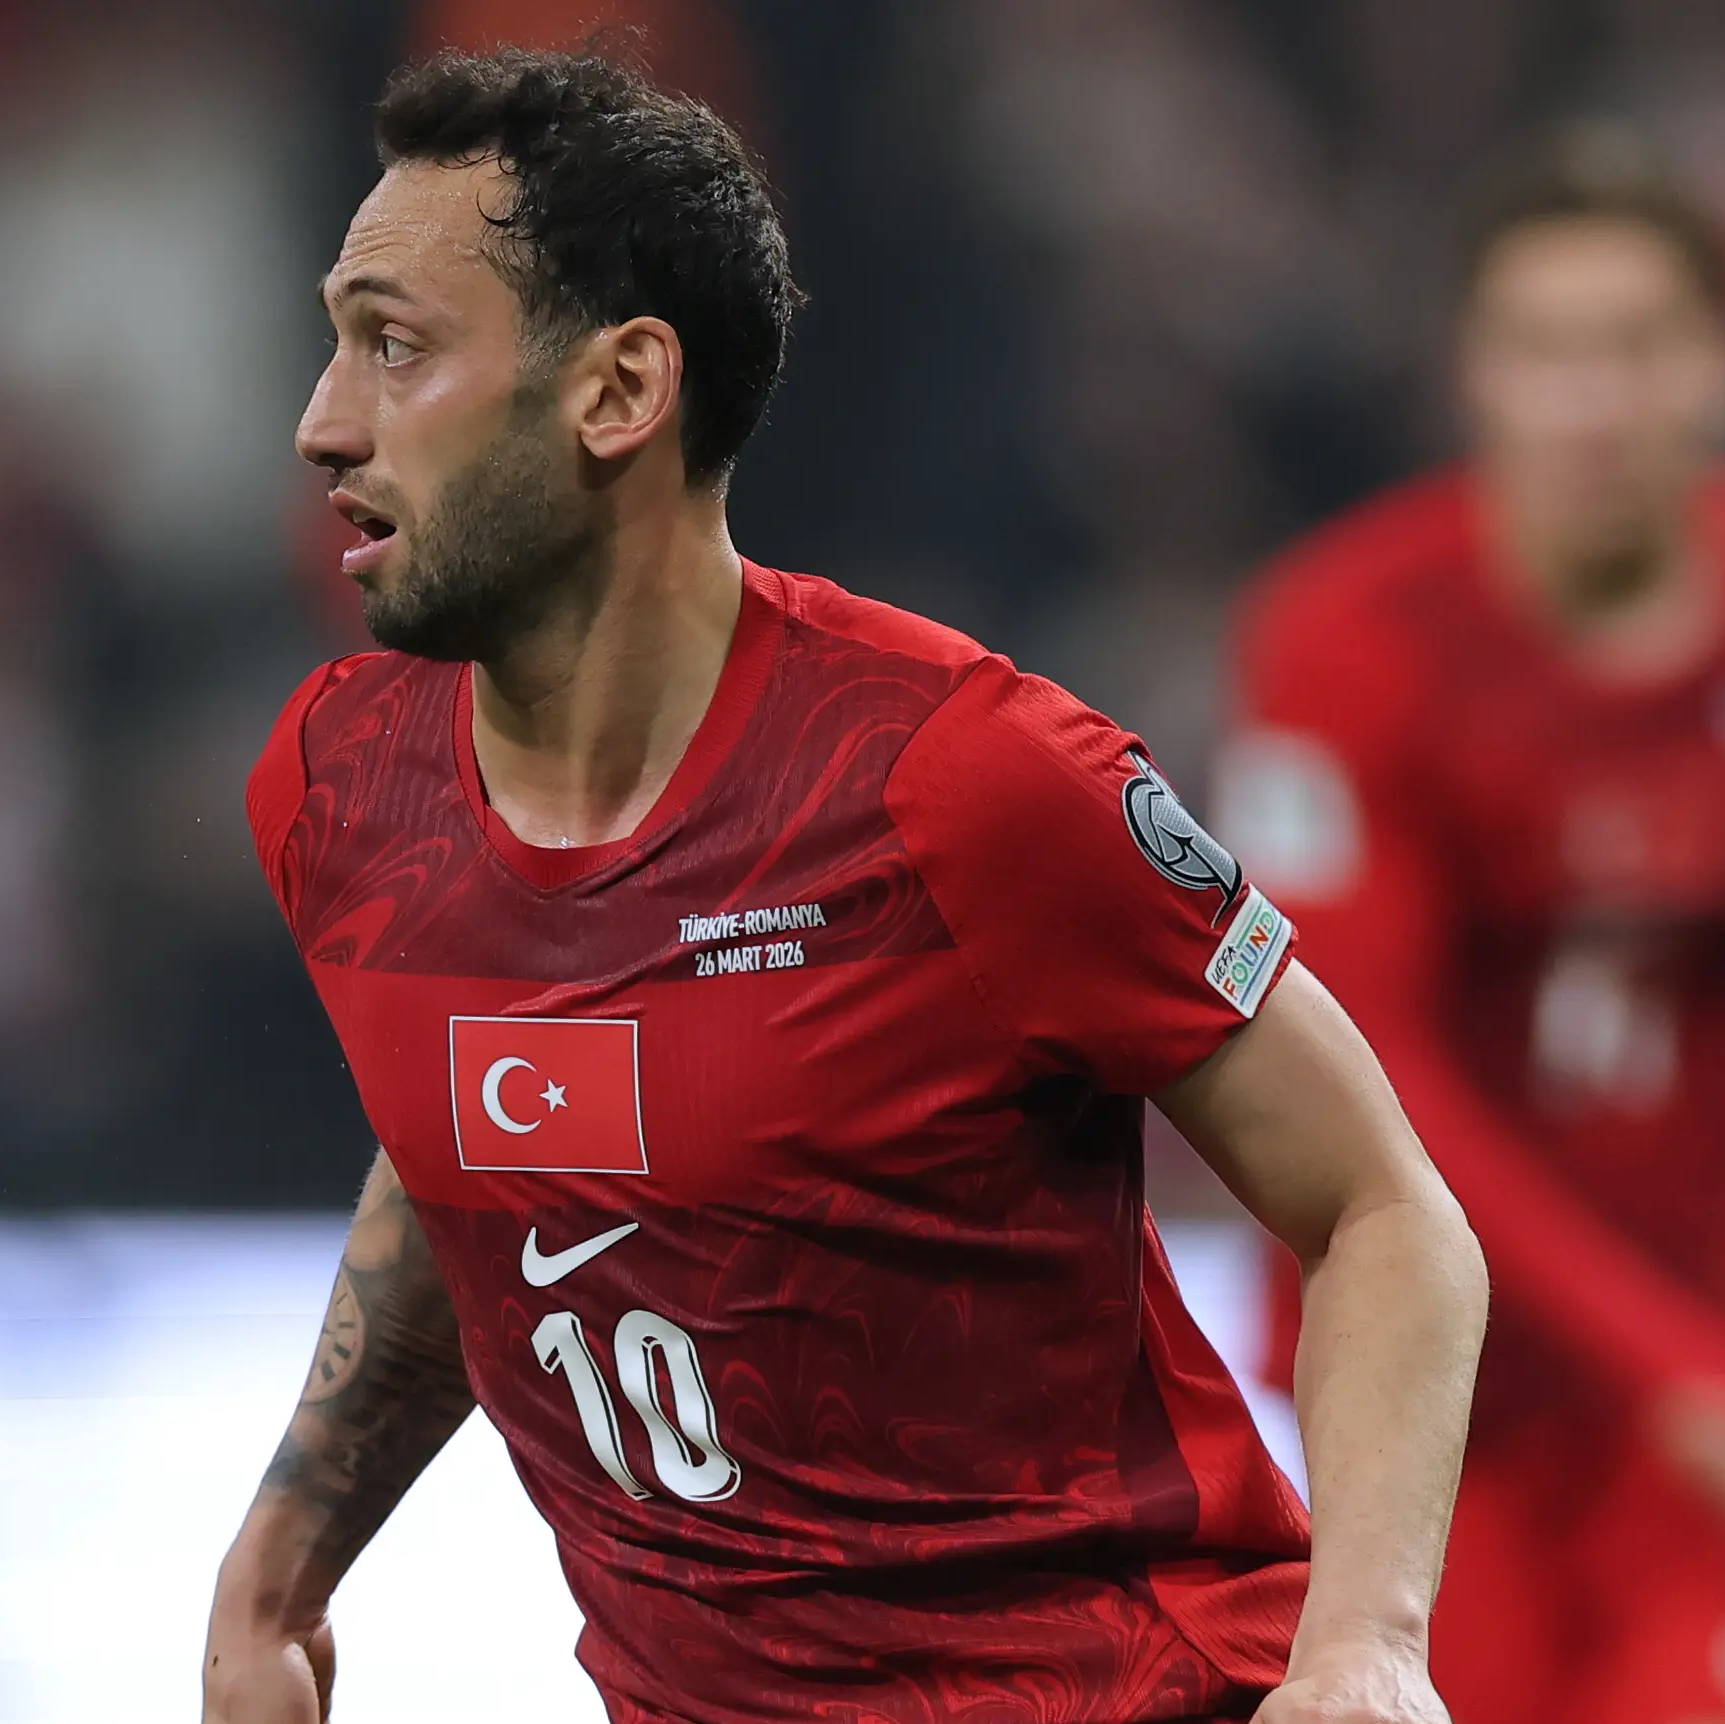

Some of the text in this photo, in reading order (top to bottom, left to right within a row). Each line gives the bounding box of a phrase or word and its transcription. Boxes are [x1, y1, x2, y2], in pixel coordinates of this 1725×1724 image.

[678, 902, 827, 944] TÜRKİYE-ROMANYA
[695, 940, 805, 977] 26 MART 2026
[1211, 945, 1237, 985] UEFA
[530, 1308, 743, 1502] 10
